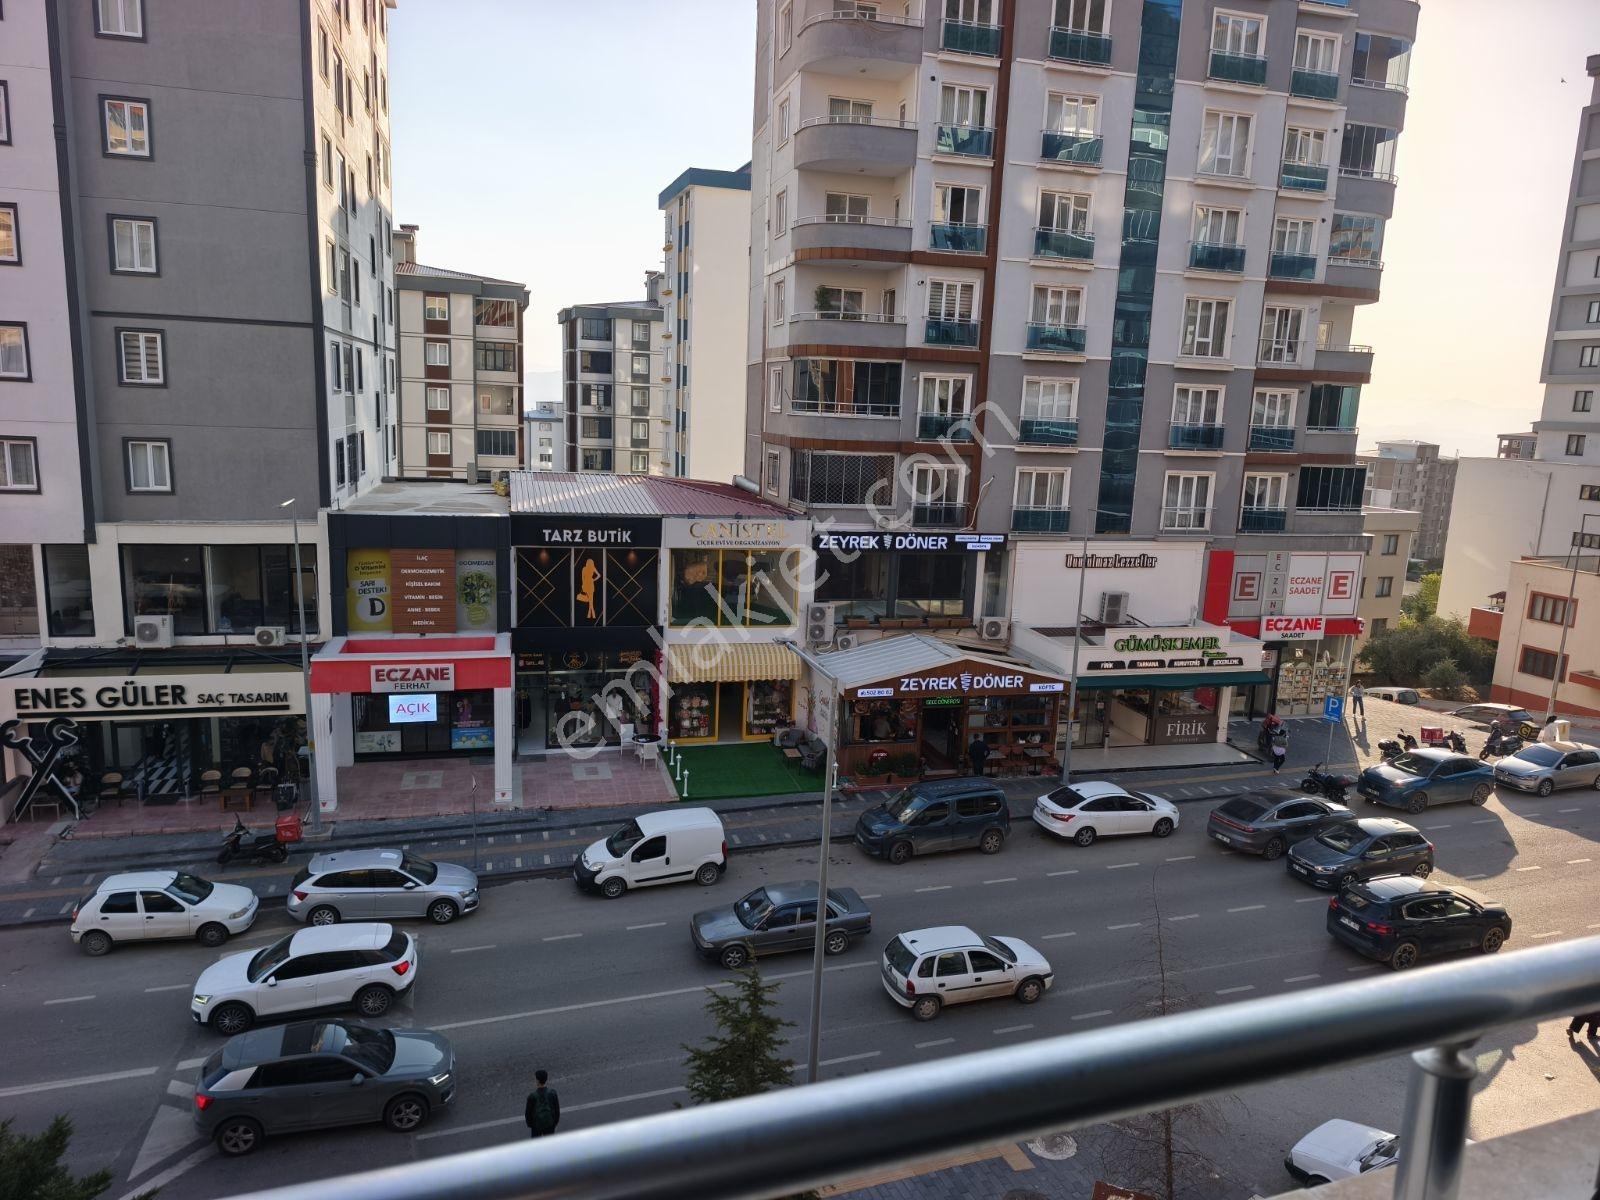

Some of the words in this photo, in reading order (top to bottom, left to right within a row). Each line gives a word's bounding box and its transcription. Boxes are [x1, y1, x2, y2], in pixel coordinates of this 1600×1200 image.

[542, 529, 583, 542] TARZ
[587, 528, 632, 543] BUTİK
[819, 535, 880, 549] ZEYREK
[895, 533, 948, 550] DÖNER
[360, 580, 376, 588] SARI
[1239, 576, 1256, 596] E
[1290, 577, 1323, 585] ECZANE
[1333, 575, 1349, 595] E
[1289, 587, 1321, 595] SAADET
[369, 598, 386, 616] D
[1265, 617, 1323, 631] ECZANE
[1114, 634, 1221, 652] GÜMÜŞKEMER
[374, 666, 451, 682] ECZANE
[900, 676, 958, 691] ZEYREK
[973, 673, 1024, 689] DÖNER
[394, 682, 431, 690] FERHAT
[14, 687, 87, 709] ENES
[96, 680, 187, 708] GÜLER
[197, 693, 225, 705] SAÇ
[229, 692, 288, 704] TASARIM
[395, 703, 431, 715] AÇIK
[1328, 698, 1339, 712] P
[1166, 720, 1207, 737] FİRİK
